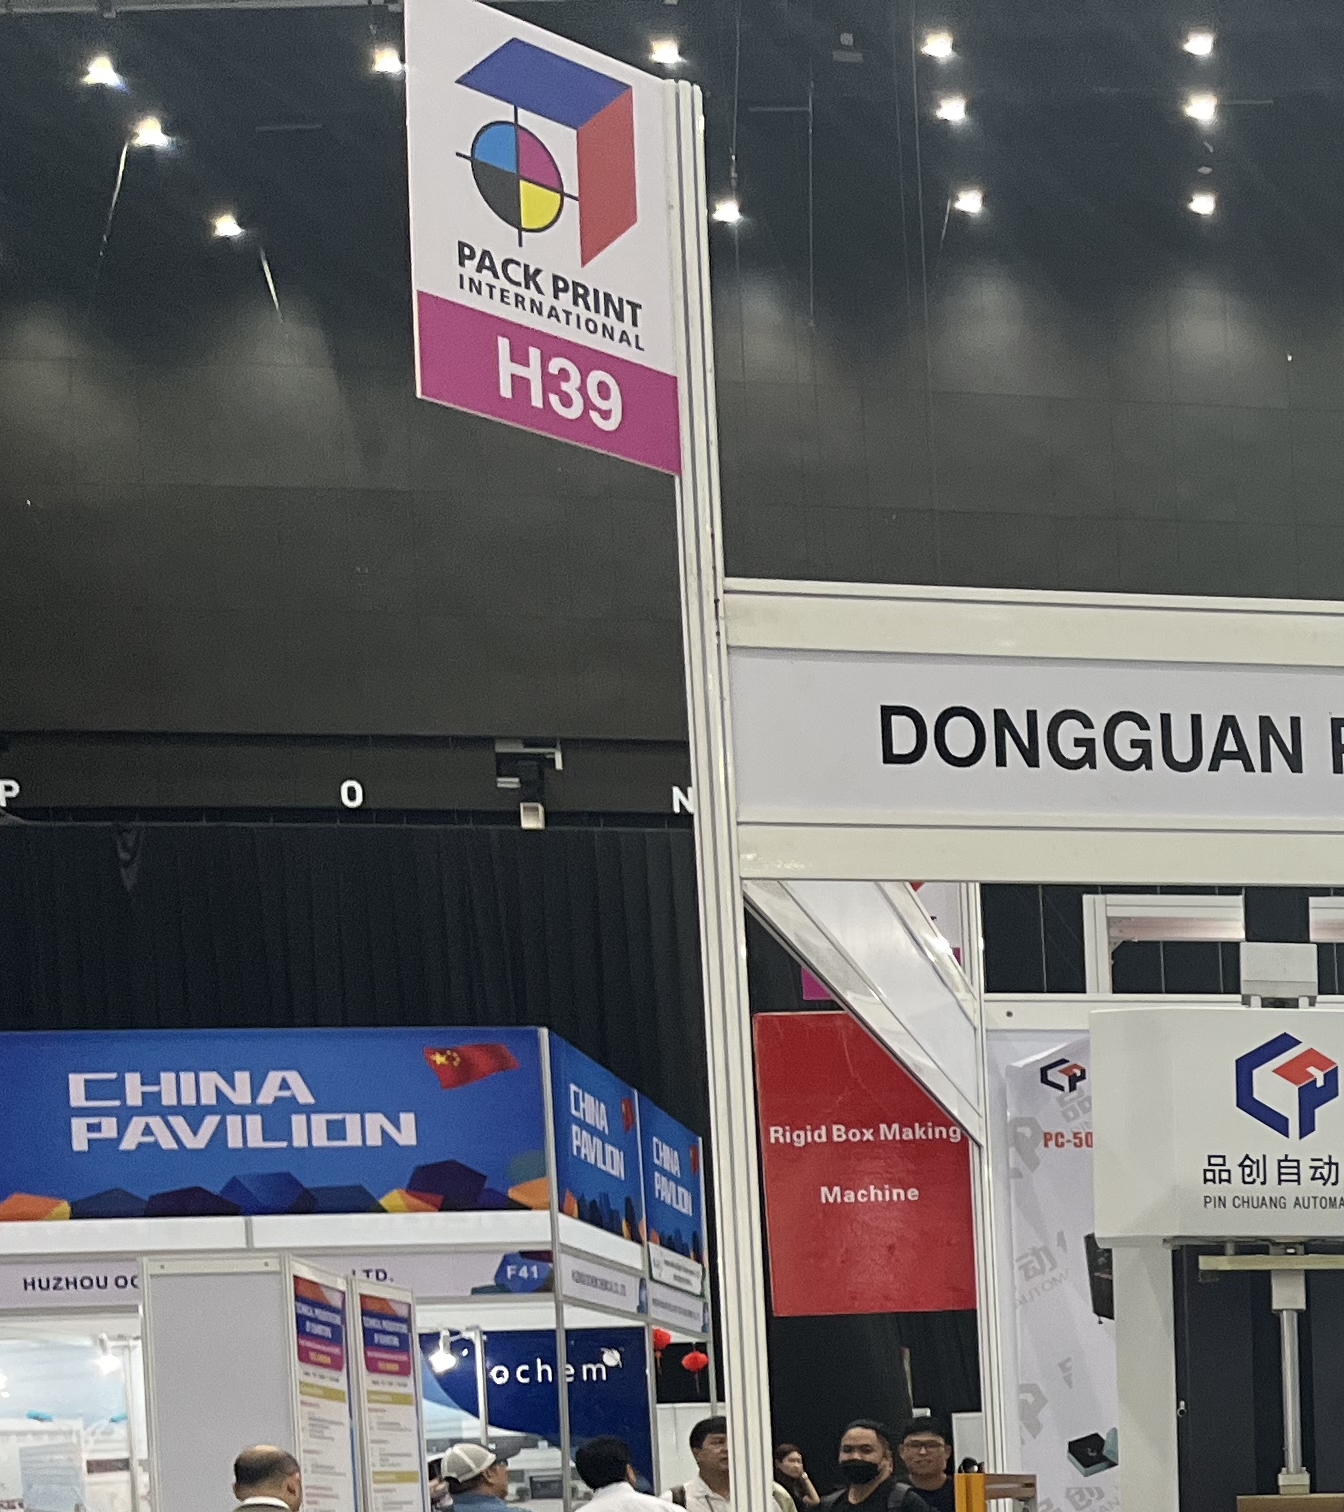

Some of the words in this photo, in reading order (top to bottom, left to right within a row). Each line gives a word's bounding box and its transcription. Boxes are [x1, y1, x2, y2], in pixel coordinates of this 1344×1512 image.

[456, 240, 544, 296] PACK
[551, 272, 643, 329] PRINT
[458, 273, 646, 352] INTERNATIONAL
[496, 336, 624, 433] H39
[880, 704, 1302, 774] DONGGUAN
[67, 1070, 316, 1108] CHINA
[569, 1083, 609, 1135] CHINA
[70, 1111, 417, 1151] PAVILION
[572, 1124, 624, 1180] PAVILION
[769, 1125, 827, 1147] Rigid
[832, 1124, 874, 1142] Box
[879, 1122, 962, 1144] Making
[653, 1136, 680, 1178] CHINA
[654, 1171, 692, 1216] PAVILION
[820, 1184, 920, 1204] Machine
[1203, 1195, 1228, 1211] PIN
[1232, 1195, 1288, 1211] CHUANG
[23, 1275, 108, 1291] HUZHOU
[506, 1264, 539, 1281] F41
